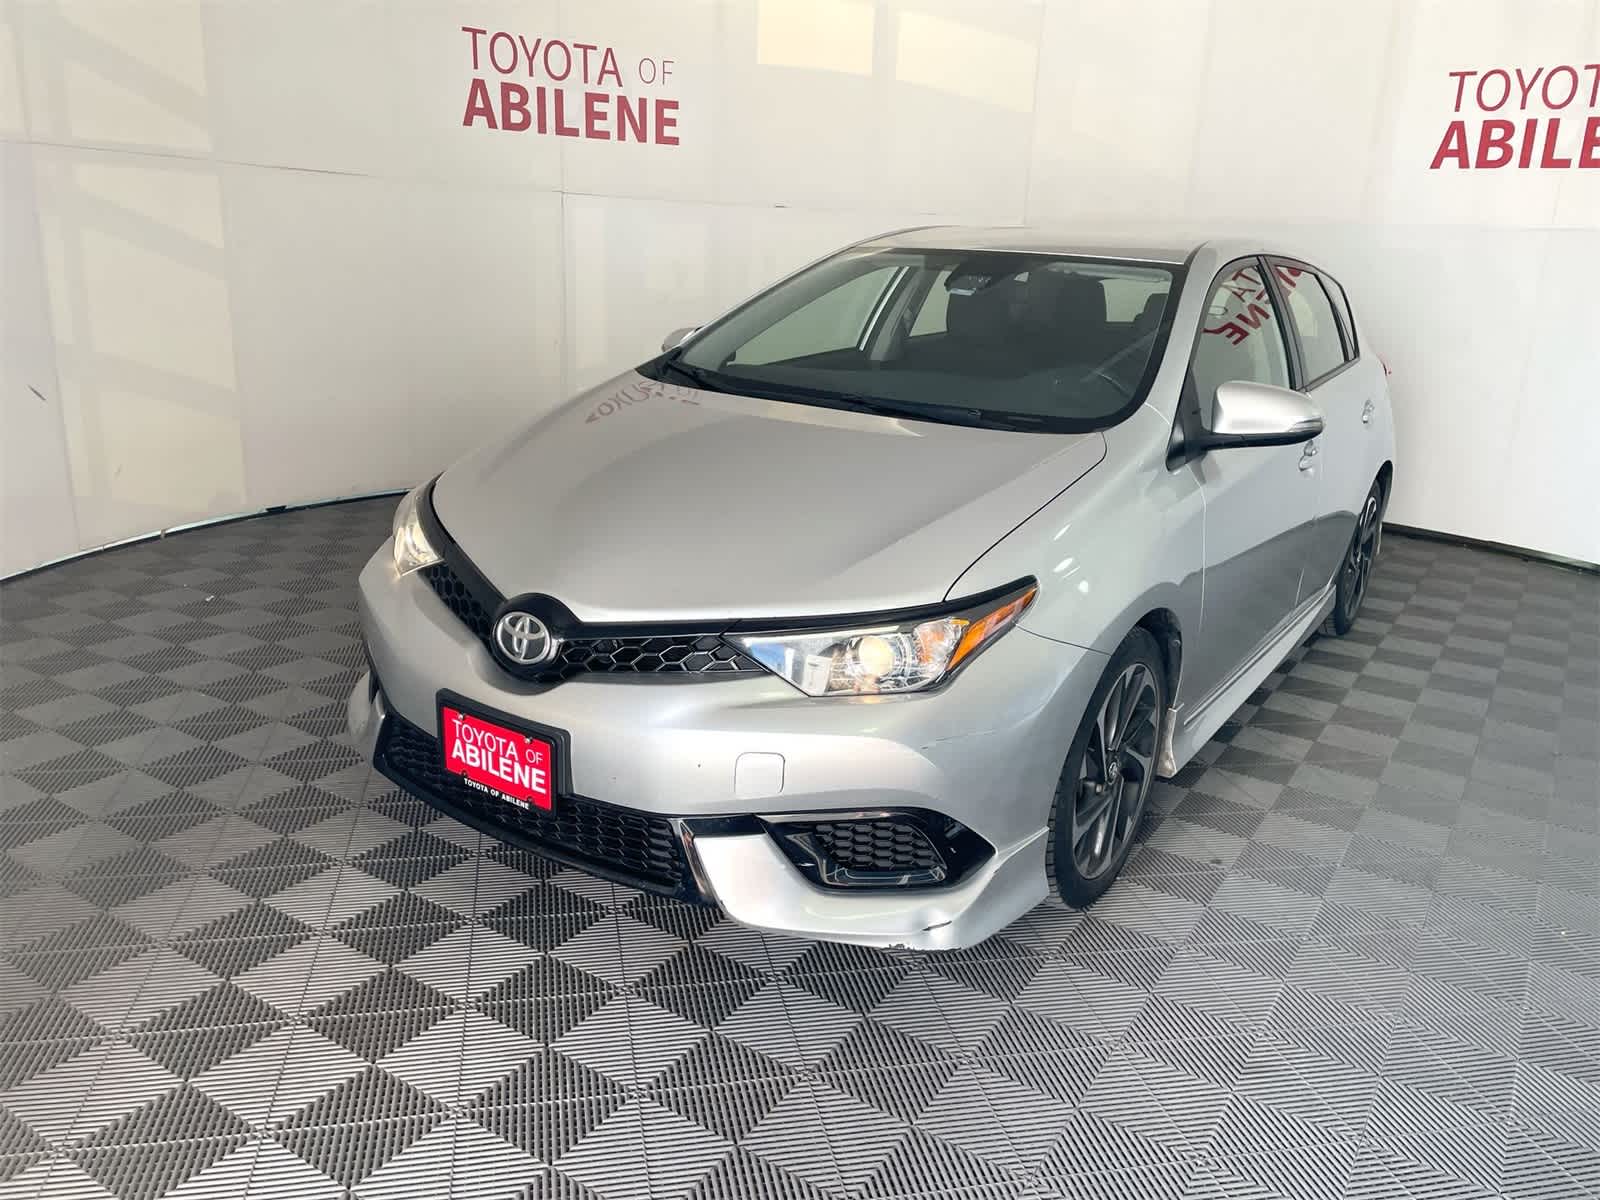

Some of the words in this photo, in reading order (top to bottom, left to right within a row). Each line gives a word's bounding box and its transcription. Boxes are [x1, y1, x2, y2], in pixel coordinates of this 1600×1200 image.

[461, 26, 623, 88] TOYOTA
[638, 57, 675, 86] OF
[462, 77, 680, 146] ABILENE
[1429, 116, 1600, 170] ABILE
[451, 738, 546, 794] ABILENE
[452, 719, 519, 761] TOYOTA
[525, 748, 543, 765] OF
[463, 777, 489, 793] TOYOTA
[490, 788, 500, 798] OF
[501, 793, 529, 810] ABILENE
